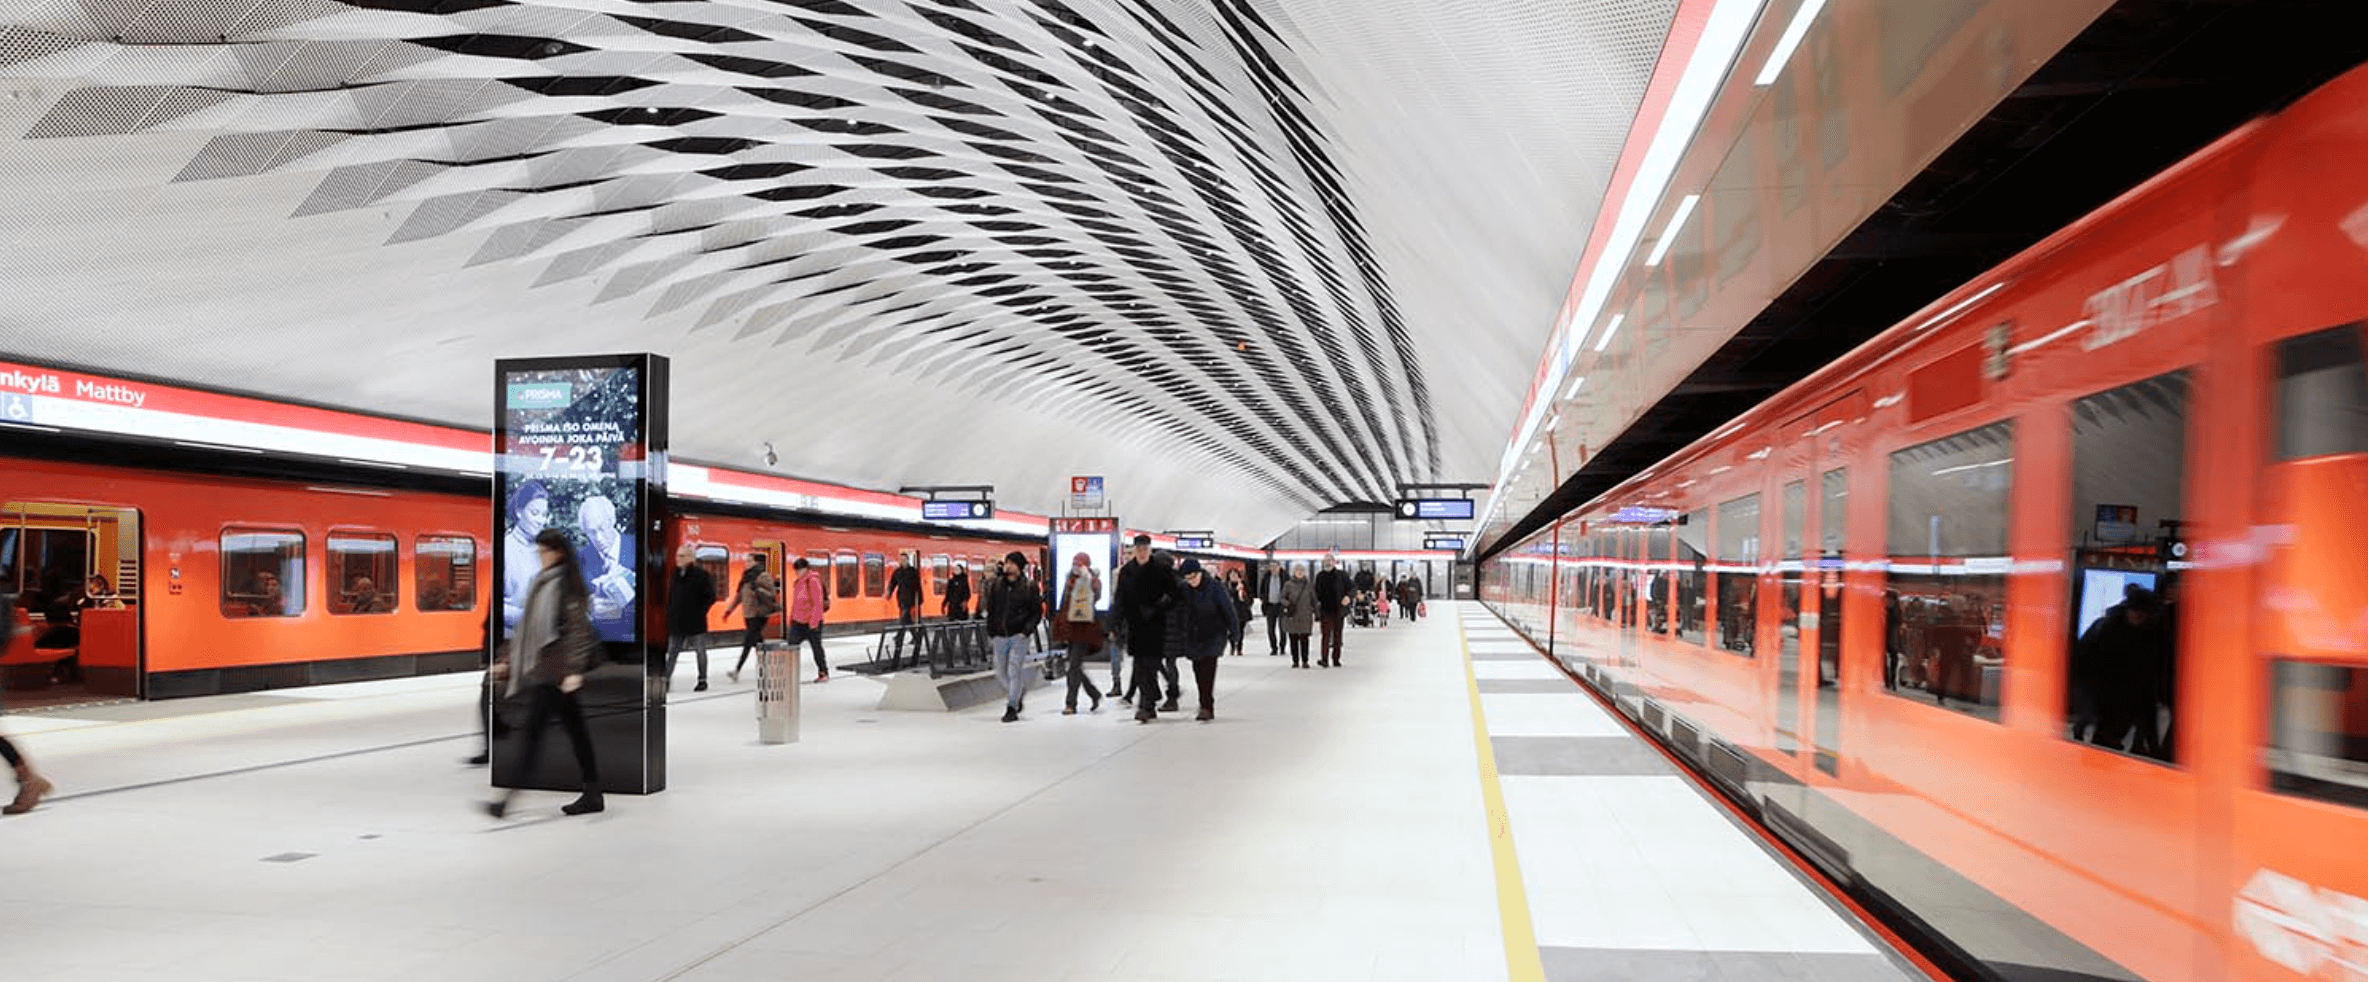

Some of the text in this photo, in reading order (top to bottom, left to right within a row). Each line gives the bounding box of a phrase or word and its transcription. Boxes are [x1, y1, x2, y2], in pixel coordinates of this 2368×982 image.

[0, 370, 146, 407] nkylä Mattby
[524, 388, 562, 400] PRISMA
[524, 421, 620, 433] PRISMA ISO OMENA
[518, 435, 564, 444] AVOINNA
[566, 434, 593, 443] JOKA
